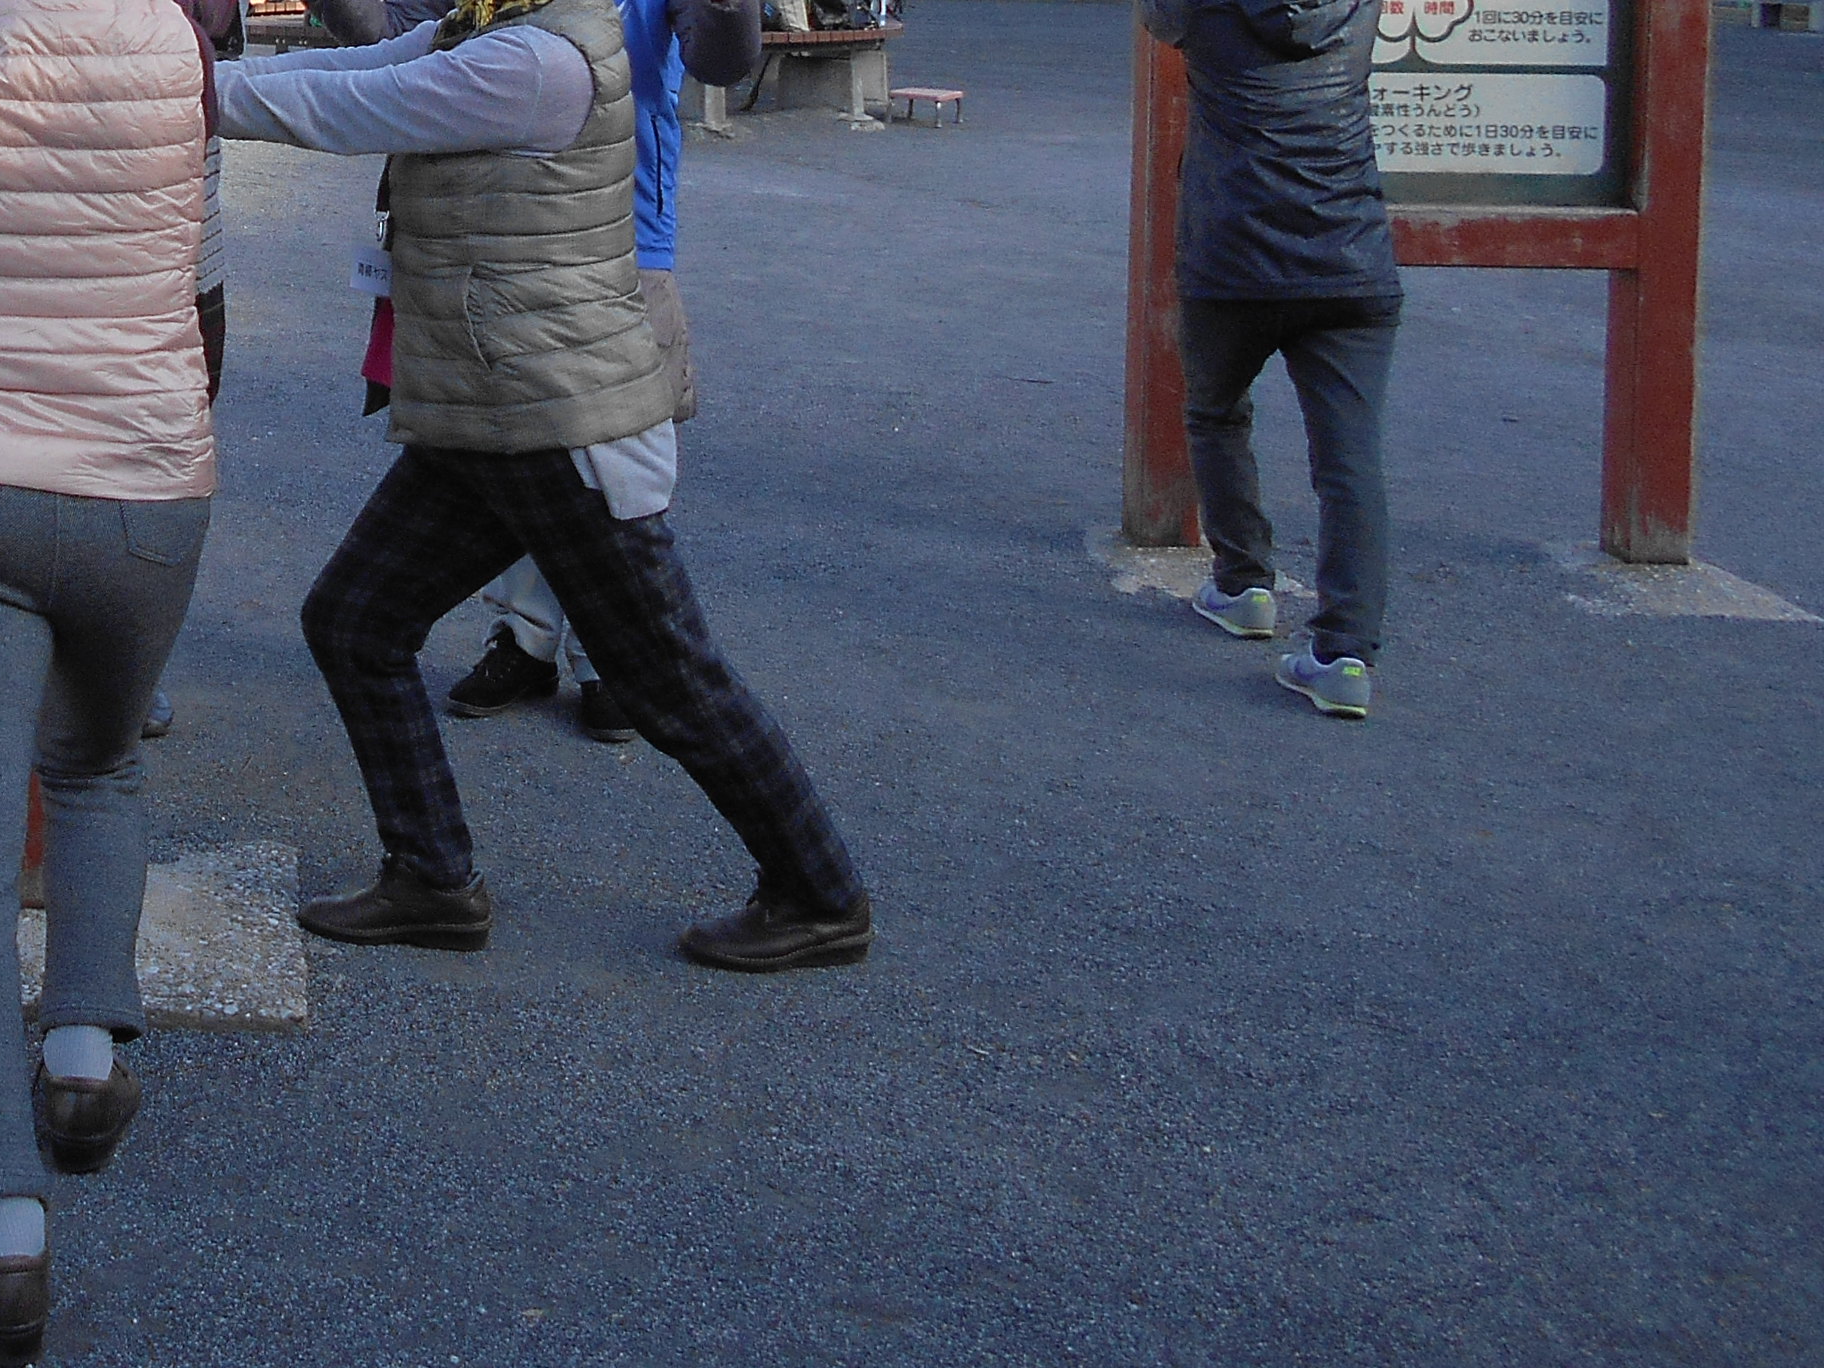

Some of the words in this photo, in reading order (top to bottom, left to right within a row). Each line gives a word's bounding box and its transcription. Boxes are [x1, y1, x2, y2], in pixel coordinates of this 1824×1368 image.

[1423, 0, 1456, 16] 時間
[1474, 9, 1604, 26] 1回に30分を目安に
[1467, 28, 1592, 45] おこないましょう。
